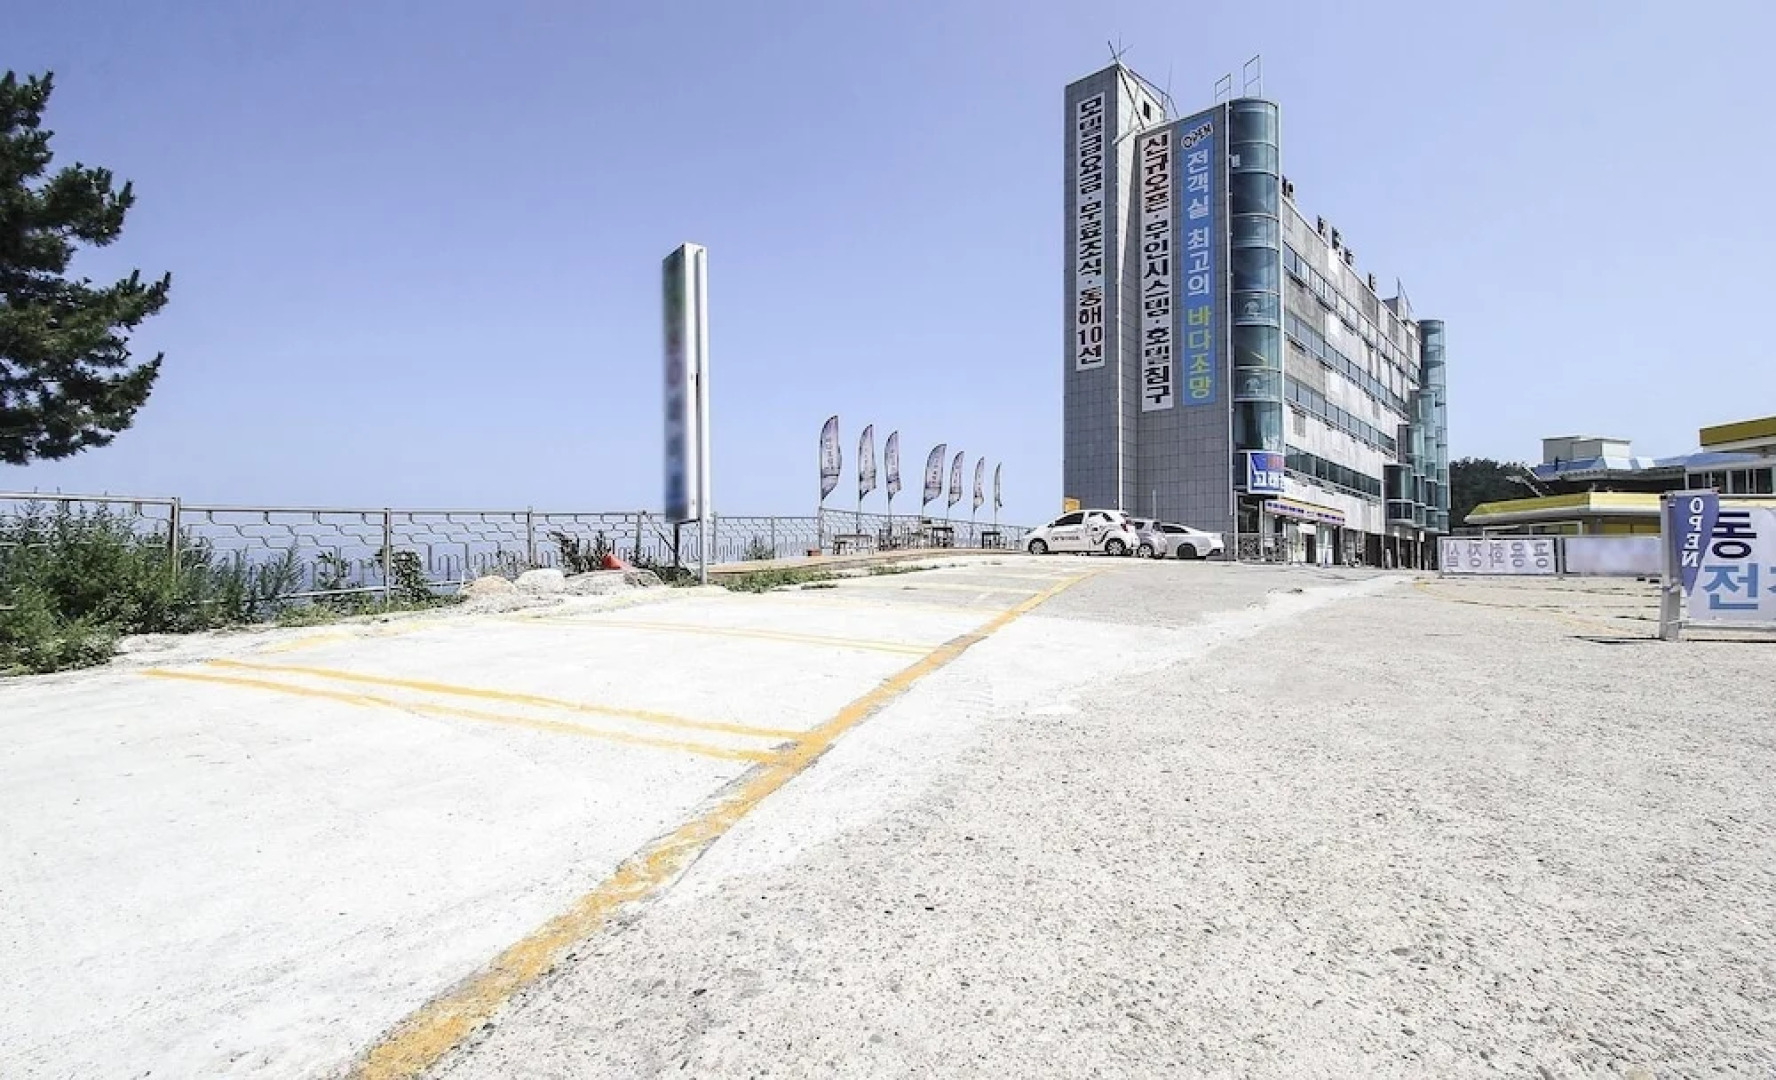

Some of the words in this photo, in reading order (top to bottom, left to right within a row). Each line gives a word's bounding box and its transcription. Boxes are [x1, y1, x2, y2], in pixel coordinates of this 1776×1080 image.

[1183, 122, 1212, 148] OPEN
[1187, 148, 1209, 220] 전객실
[1187, 226, 1210, 296] 최고의
[1187, 305, 1211, 399] 바다조망
